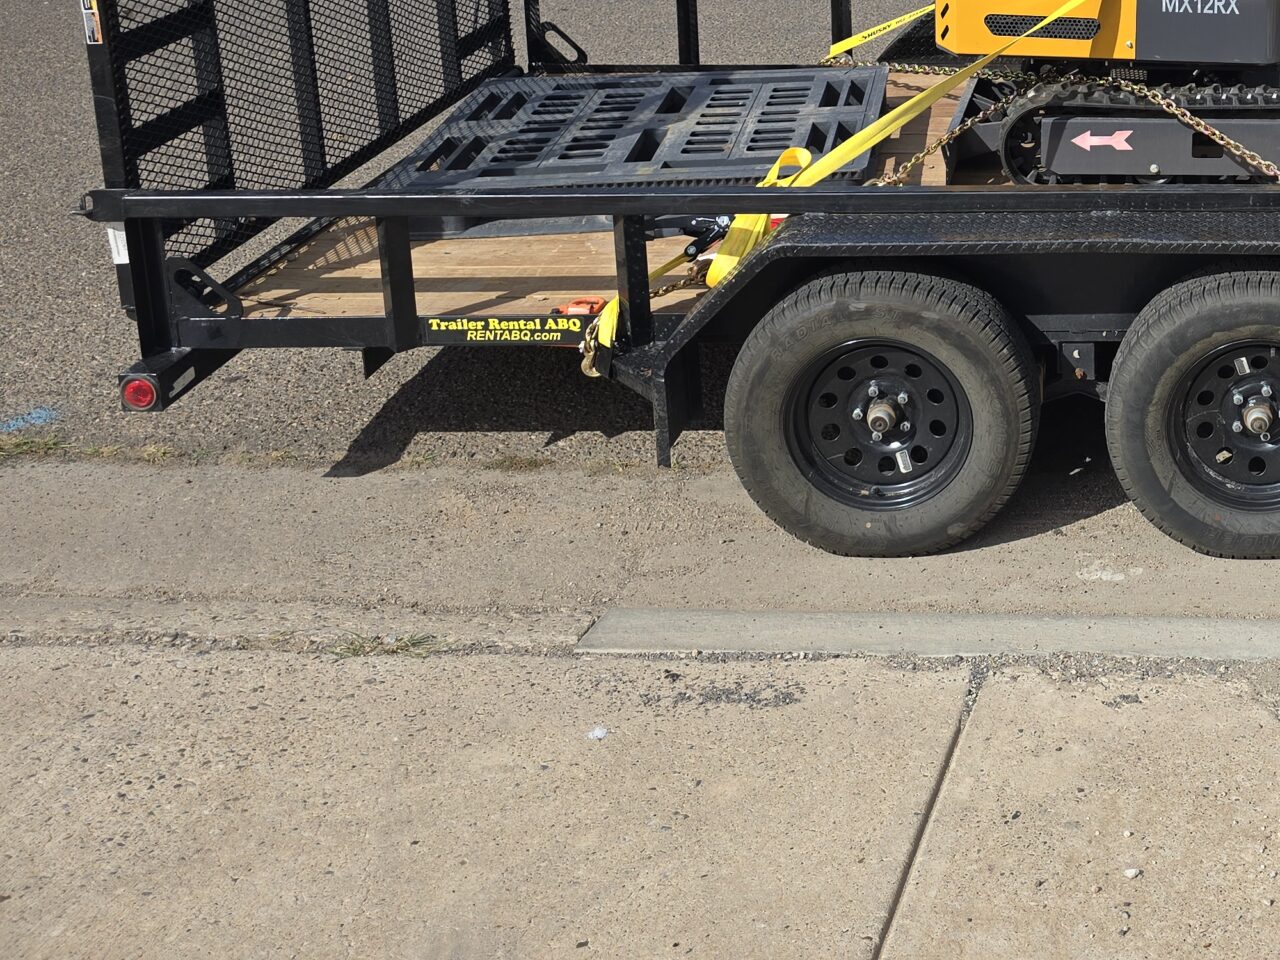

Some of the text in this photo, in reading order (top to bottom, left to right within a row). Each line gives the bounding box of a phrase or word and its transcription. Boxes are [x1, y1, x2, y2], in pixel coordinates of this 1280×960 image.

[429, 318, 581, 332] Trailer Rental ABQ
[466, 330, 561, 341] RENTABQ.com
